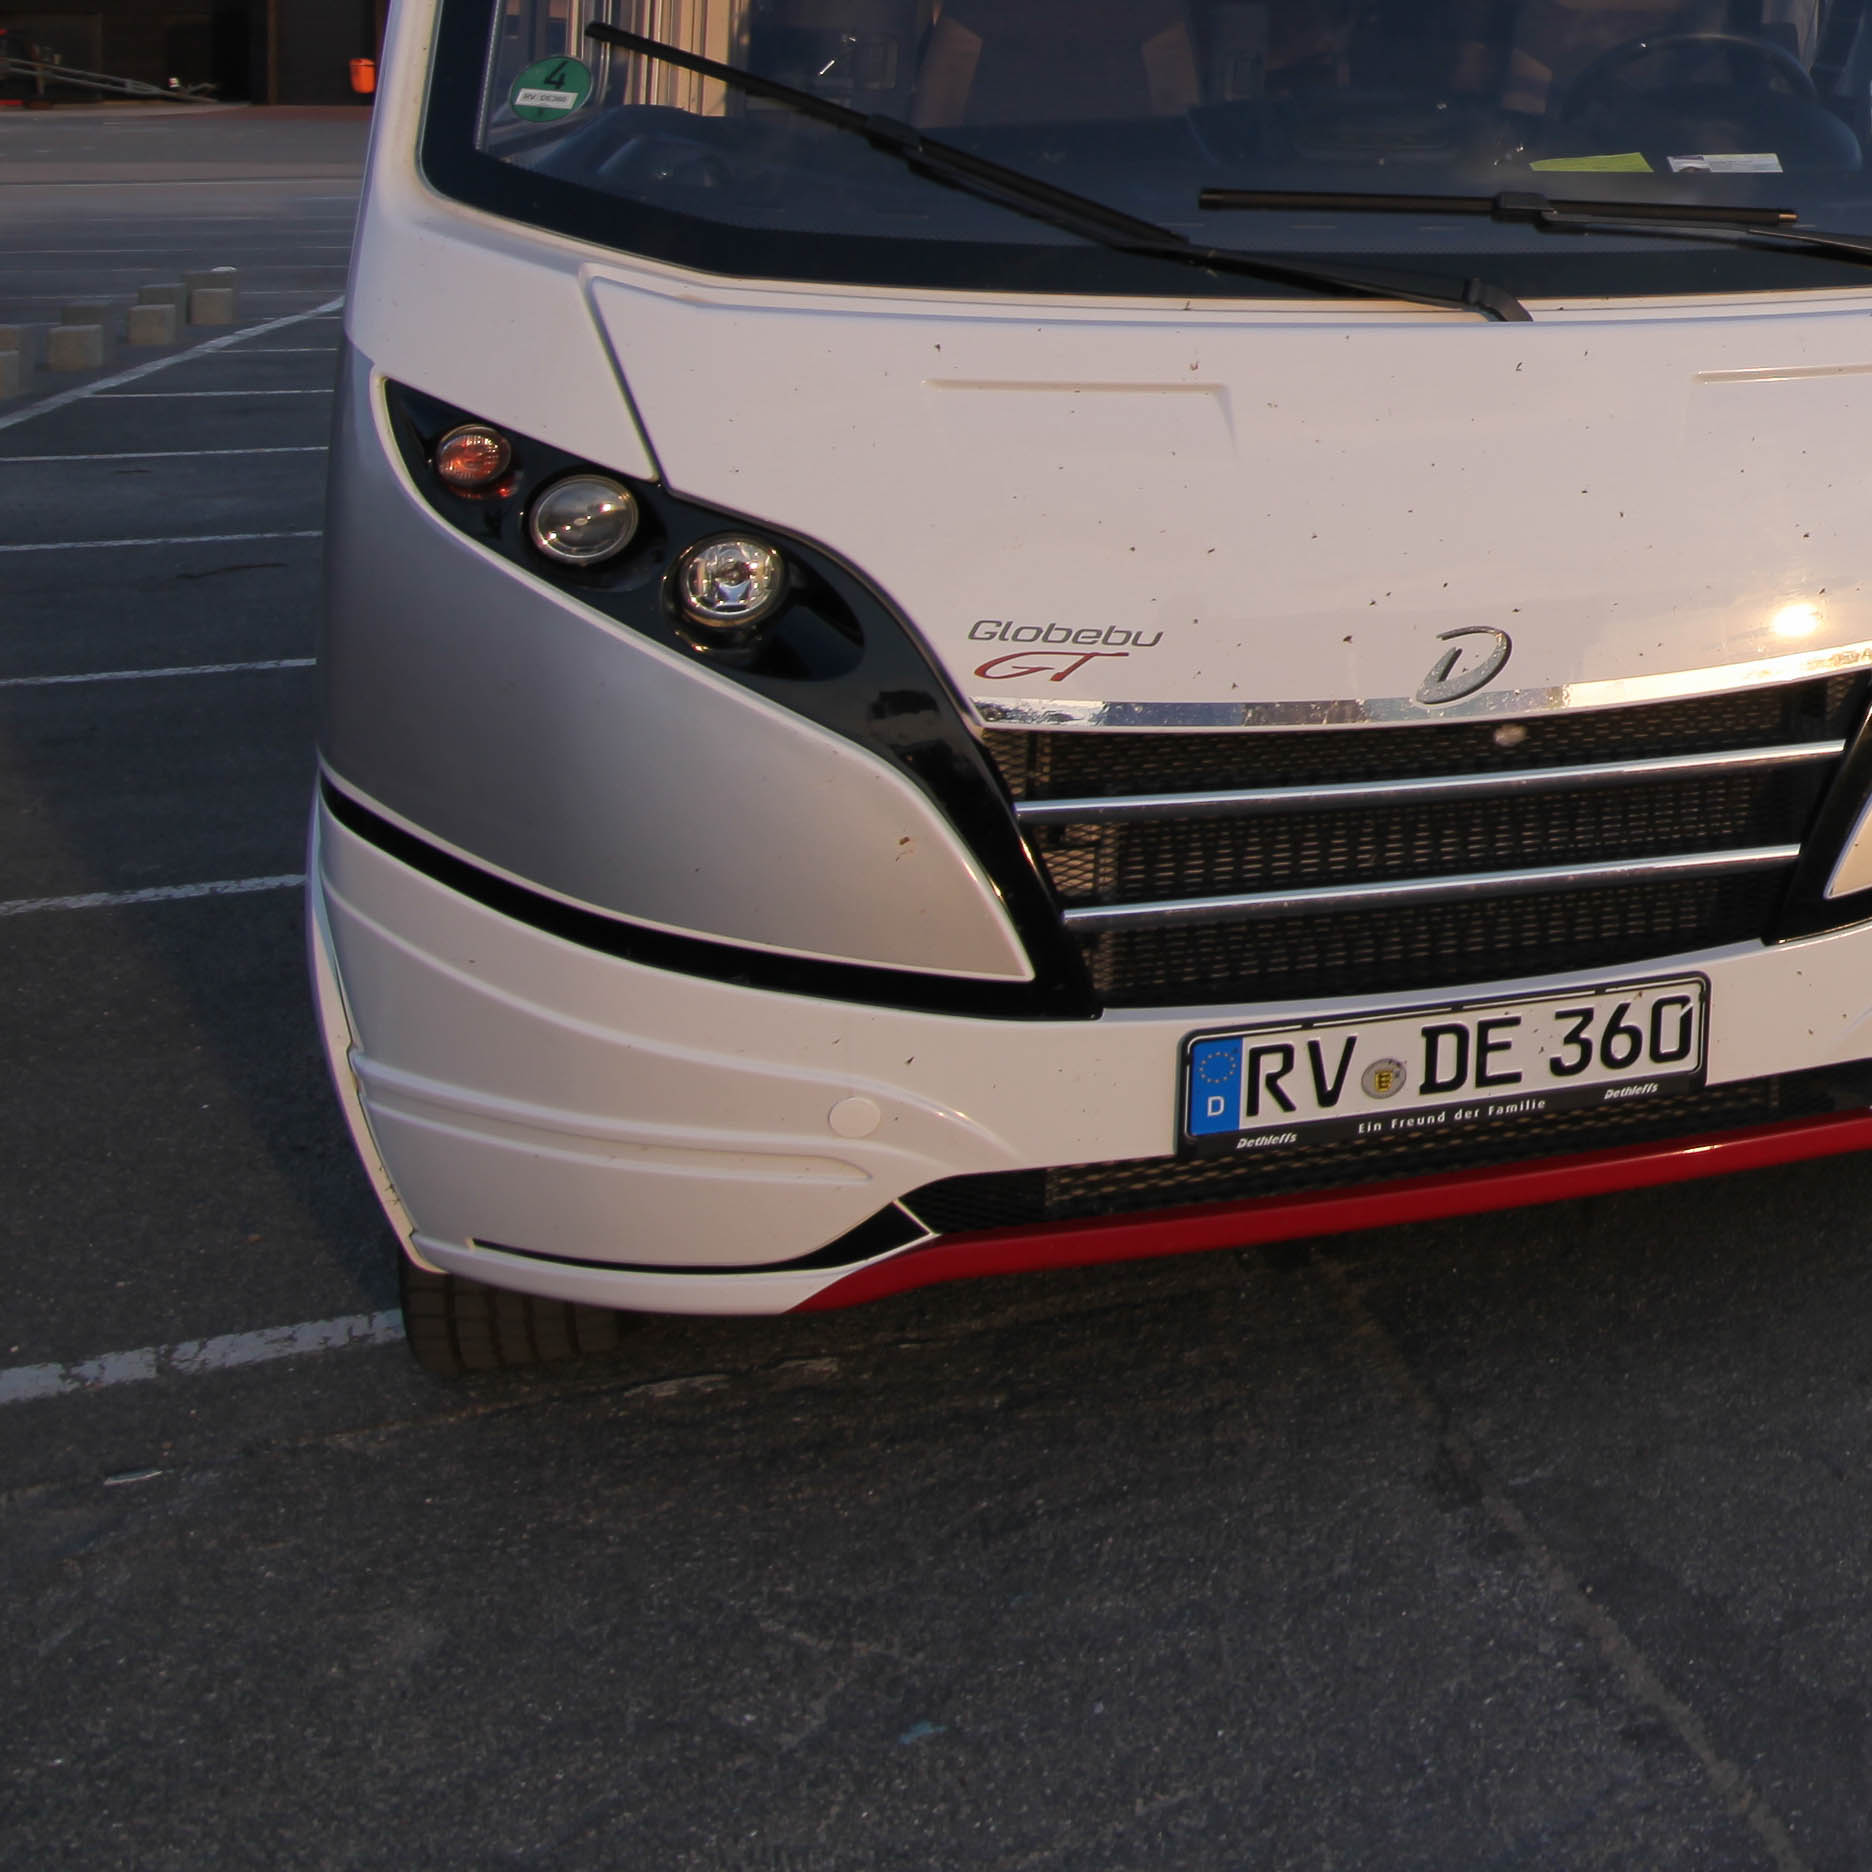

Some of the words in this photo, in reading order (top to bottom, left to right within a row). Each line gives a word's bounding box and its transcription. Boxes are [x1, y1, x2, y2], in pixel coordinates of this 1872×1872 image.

[543, 60, 568, 88] 4
[973, 651, 1129, 682] GT
[1246, 1035, 1358, 1117] RV
[1419, 1016, 1522, 1095] DE
[1549, 995, 1693, 1077] 360
[1604, 1082, 1659, 1100] Dethleffs
[1207, 1095, 1225, 1117] D
[1358, 1122, 1382, 1134] Ein
[1391, 1110, 1446, 1128] Freund
[1454, 1108, 1480, 1121] der
[1488, 1099, 1546, 1116] Familie
[1236, 1131, 1297, 1149] Dethleffs
